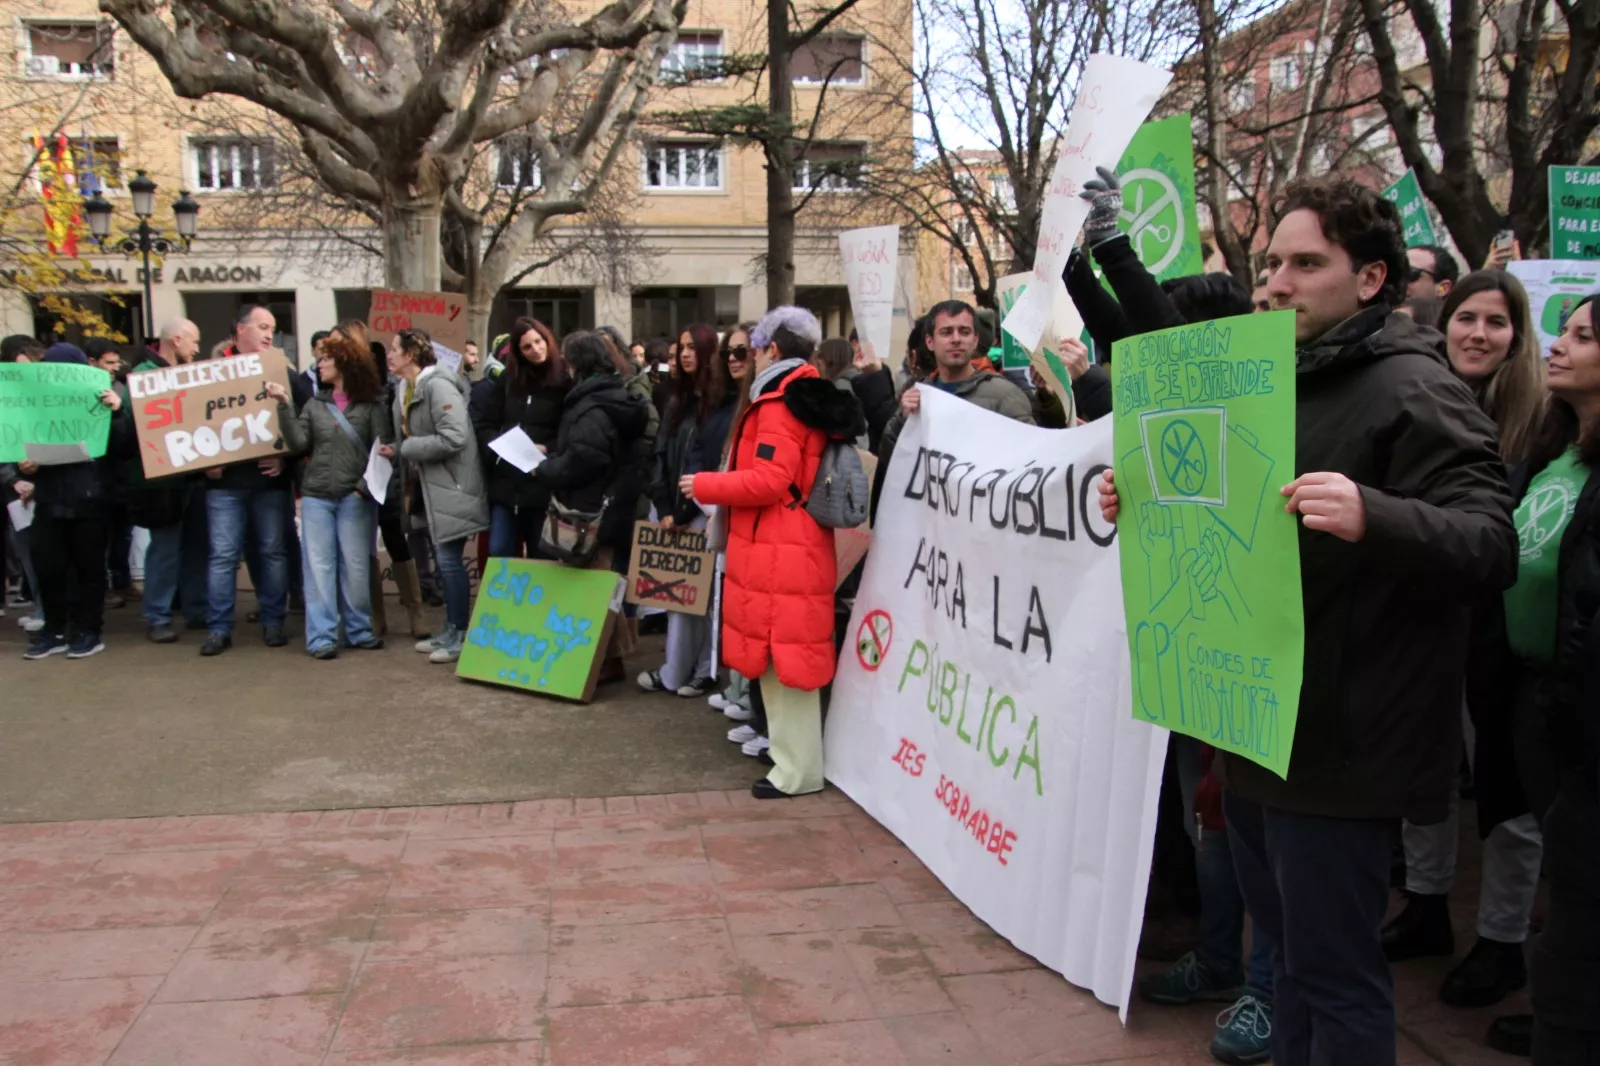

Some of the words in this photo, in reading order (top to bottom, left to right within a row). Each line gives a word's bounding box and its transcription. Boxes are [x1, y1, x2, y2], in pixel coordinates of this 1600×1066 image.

[1567, 240, 1581, 254] DE
[1590, 219, 1600, 232] E
[1138, 320, 1231, 369] EDUCACIÓN
[127, 354, 263, 398] CONCIERTOS
[1154, 363, 1183, 406] SE
[1185, 358, 1275, 404] DEFIENDE
[143, 390, 187, 430] SÍ
[205, 394, 246, 420] pero
[254, 381, 269, 401] d
[0, 419, 106, 447] DUCANDO
[164, 408, 274, 468] ROCK
[639, 548, 702, 576] DERECHO
[993, 575, 1052, 663] LA
[1251, 656, 1274, 680] DE
[898, 638, 1043, 796] PÚBLICA
[891, 737, 927, 777] IES
